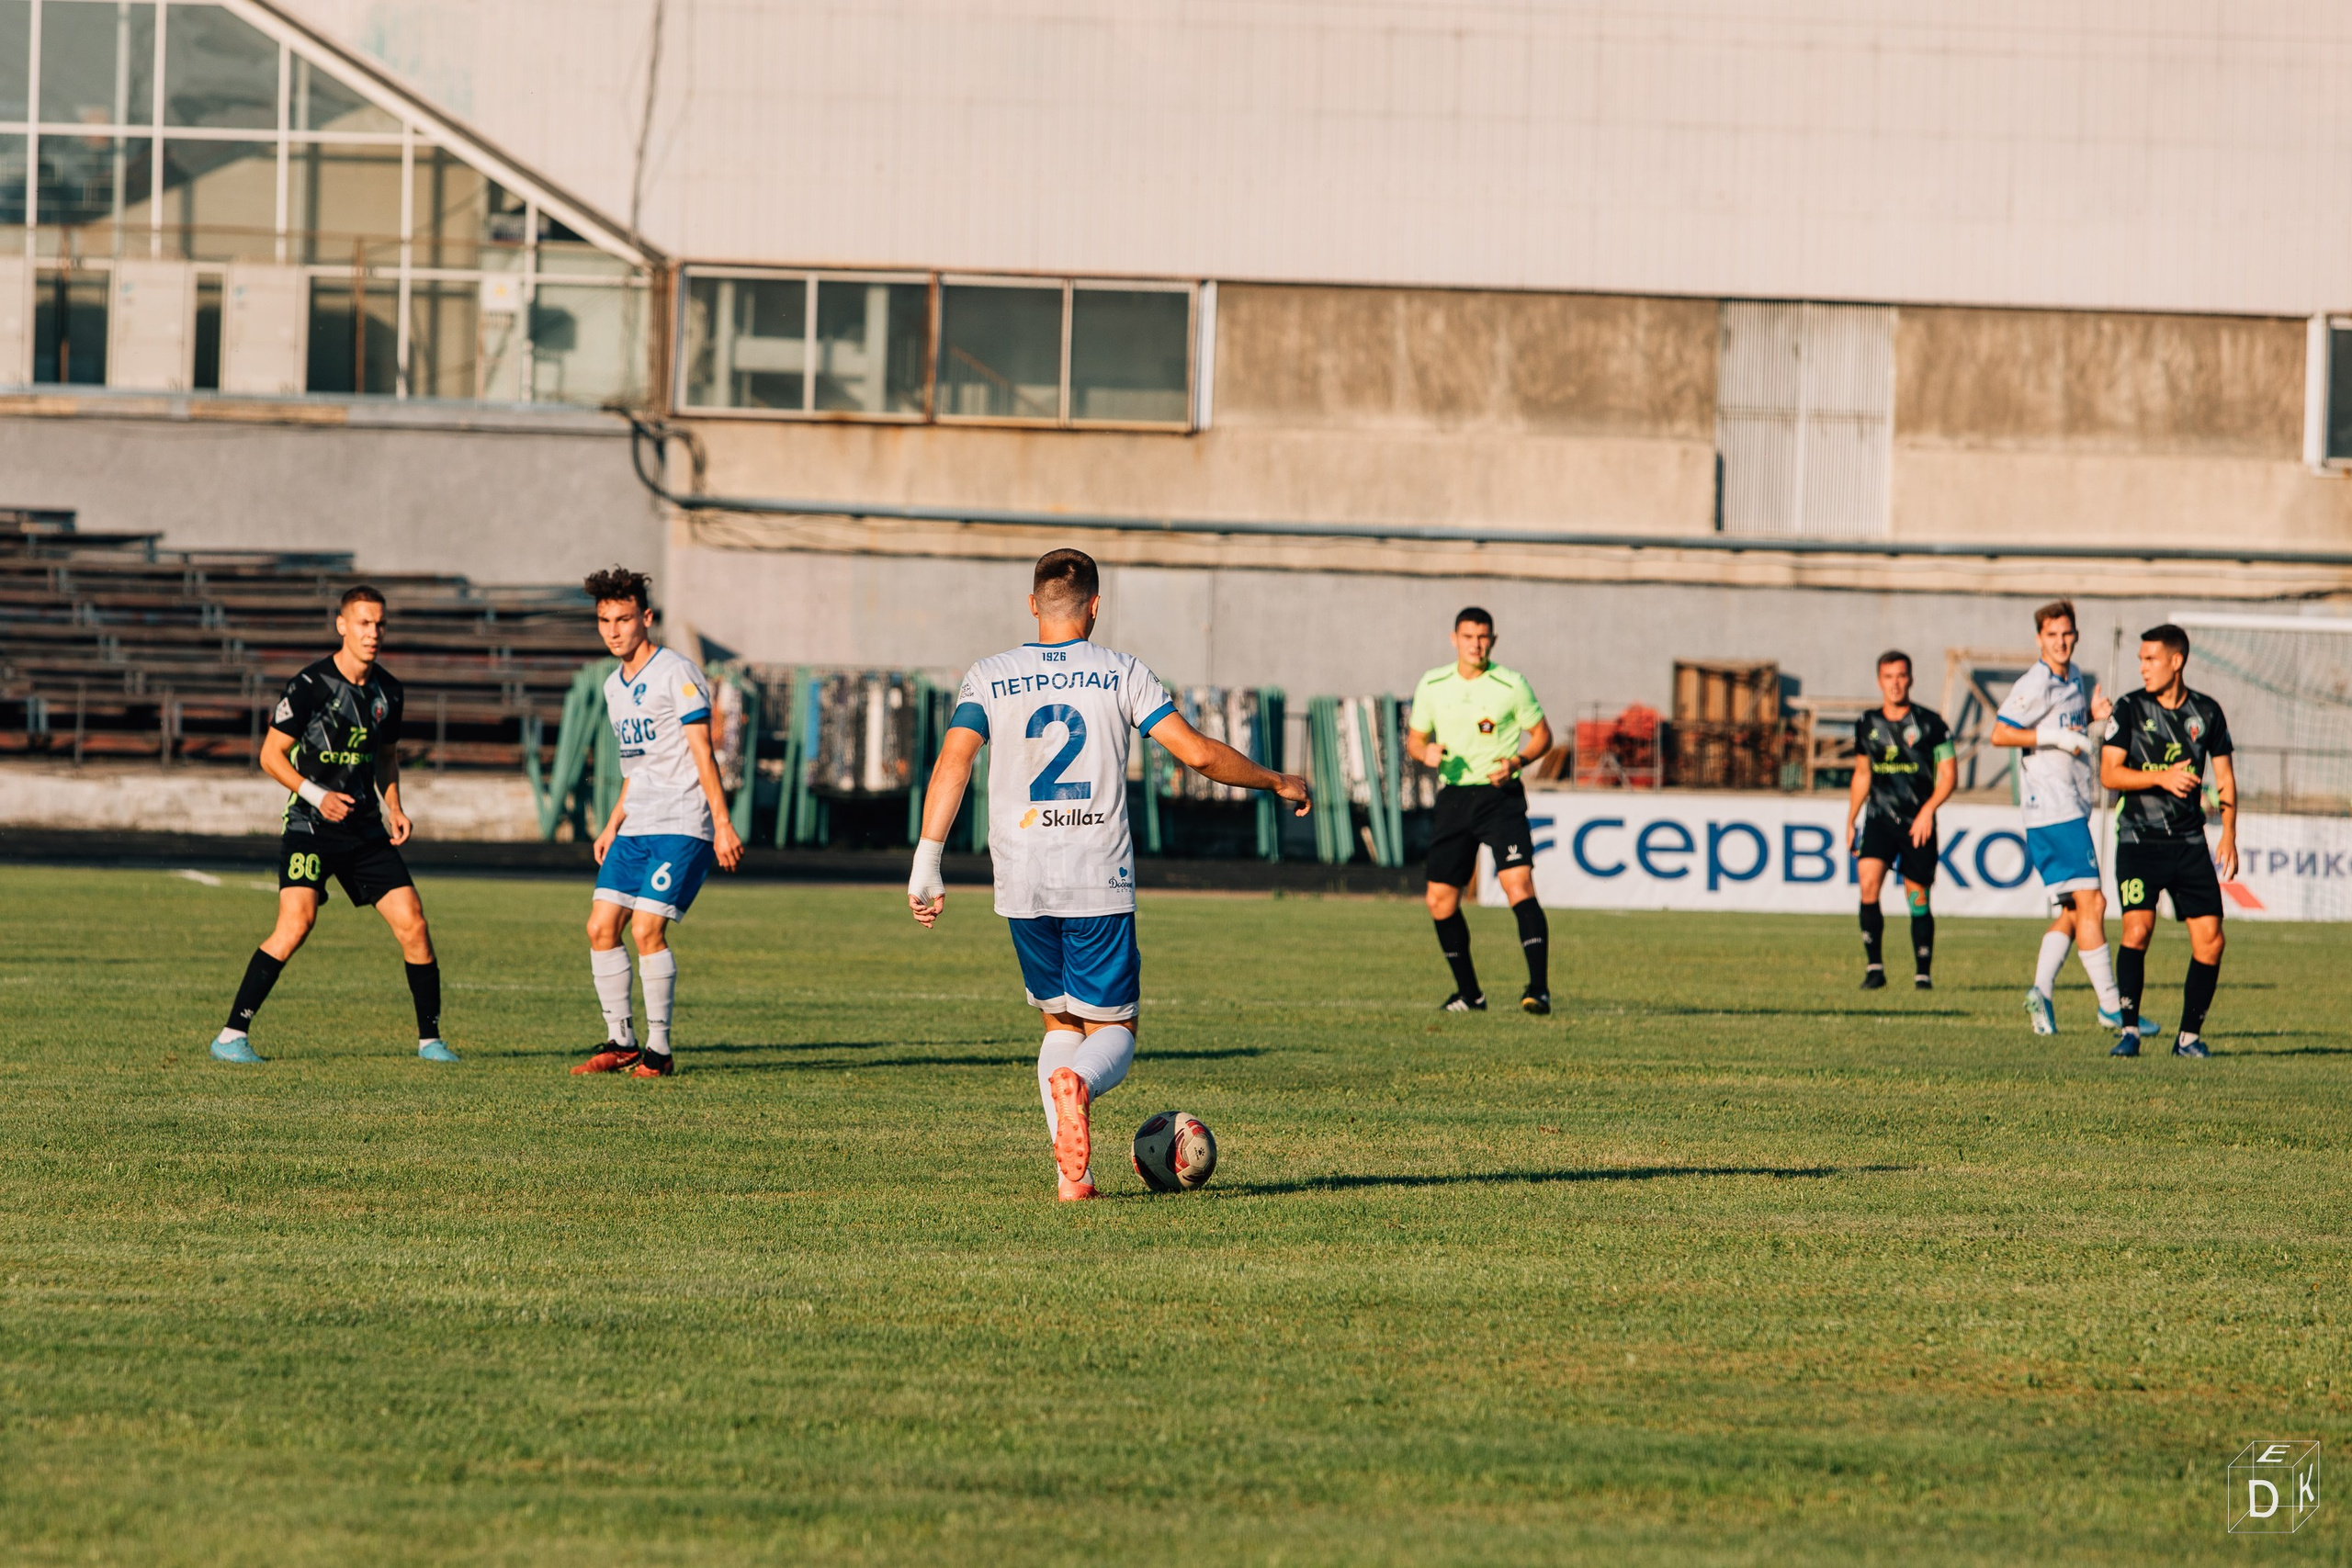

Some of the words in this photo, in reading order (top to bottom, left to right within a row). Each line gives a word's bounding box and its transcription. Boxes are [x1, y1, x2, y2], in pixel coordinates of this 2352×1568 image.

[1041, 651, 1067, 662] 1926
[990, 670, 1121, 699] ПЕТРОЛАЙ
[1024, 703, 1091, 802] 2
[1041, 808, 1105, 828] Skillaz
[288, 852, 322, 881] 80
[650, 862, 672, 892] 6
[2120, 877, 2144, 907] 18
